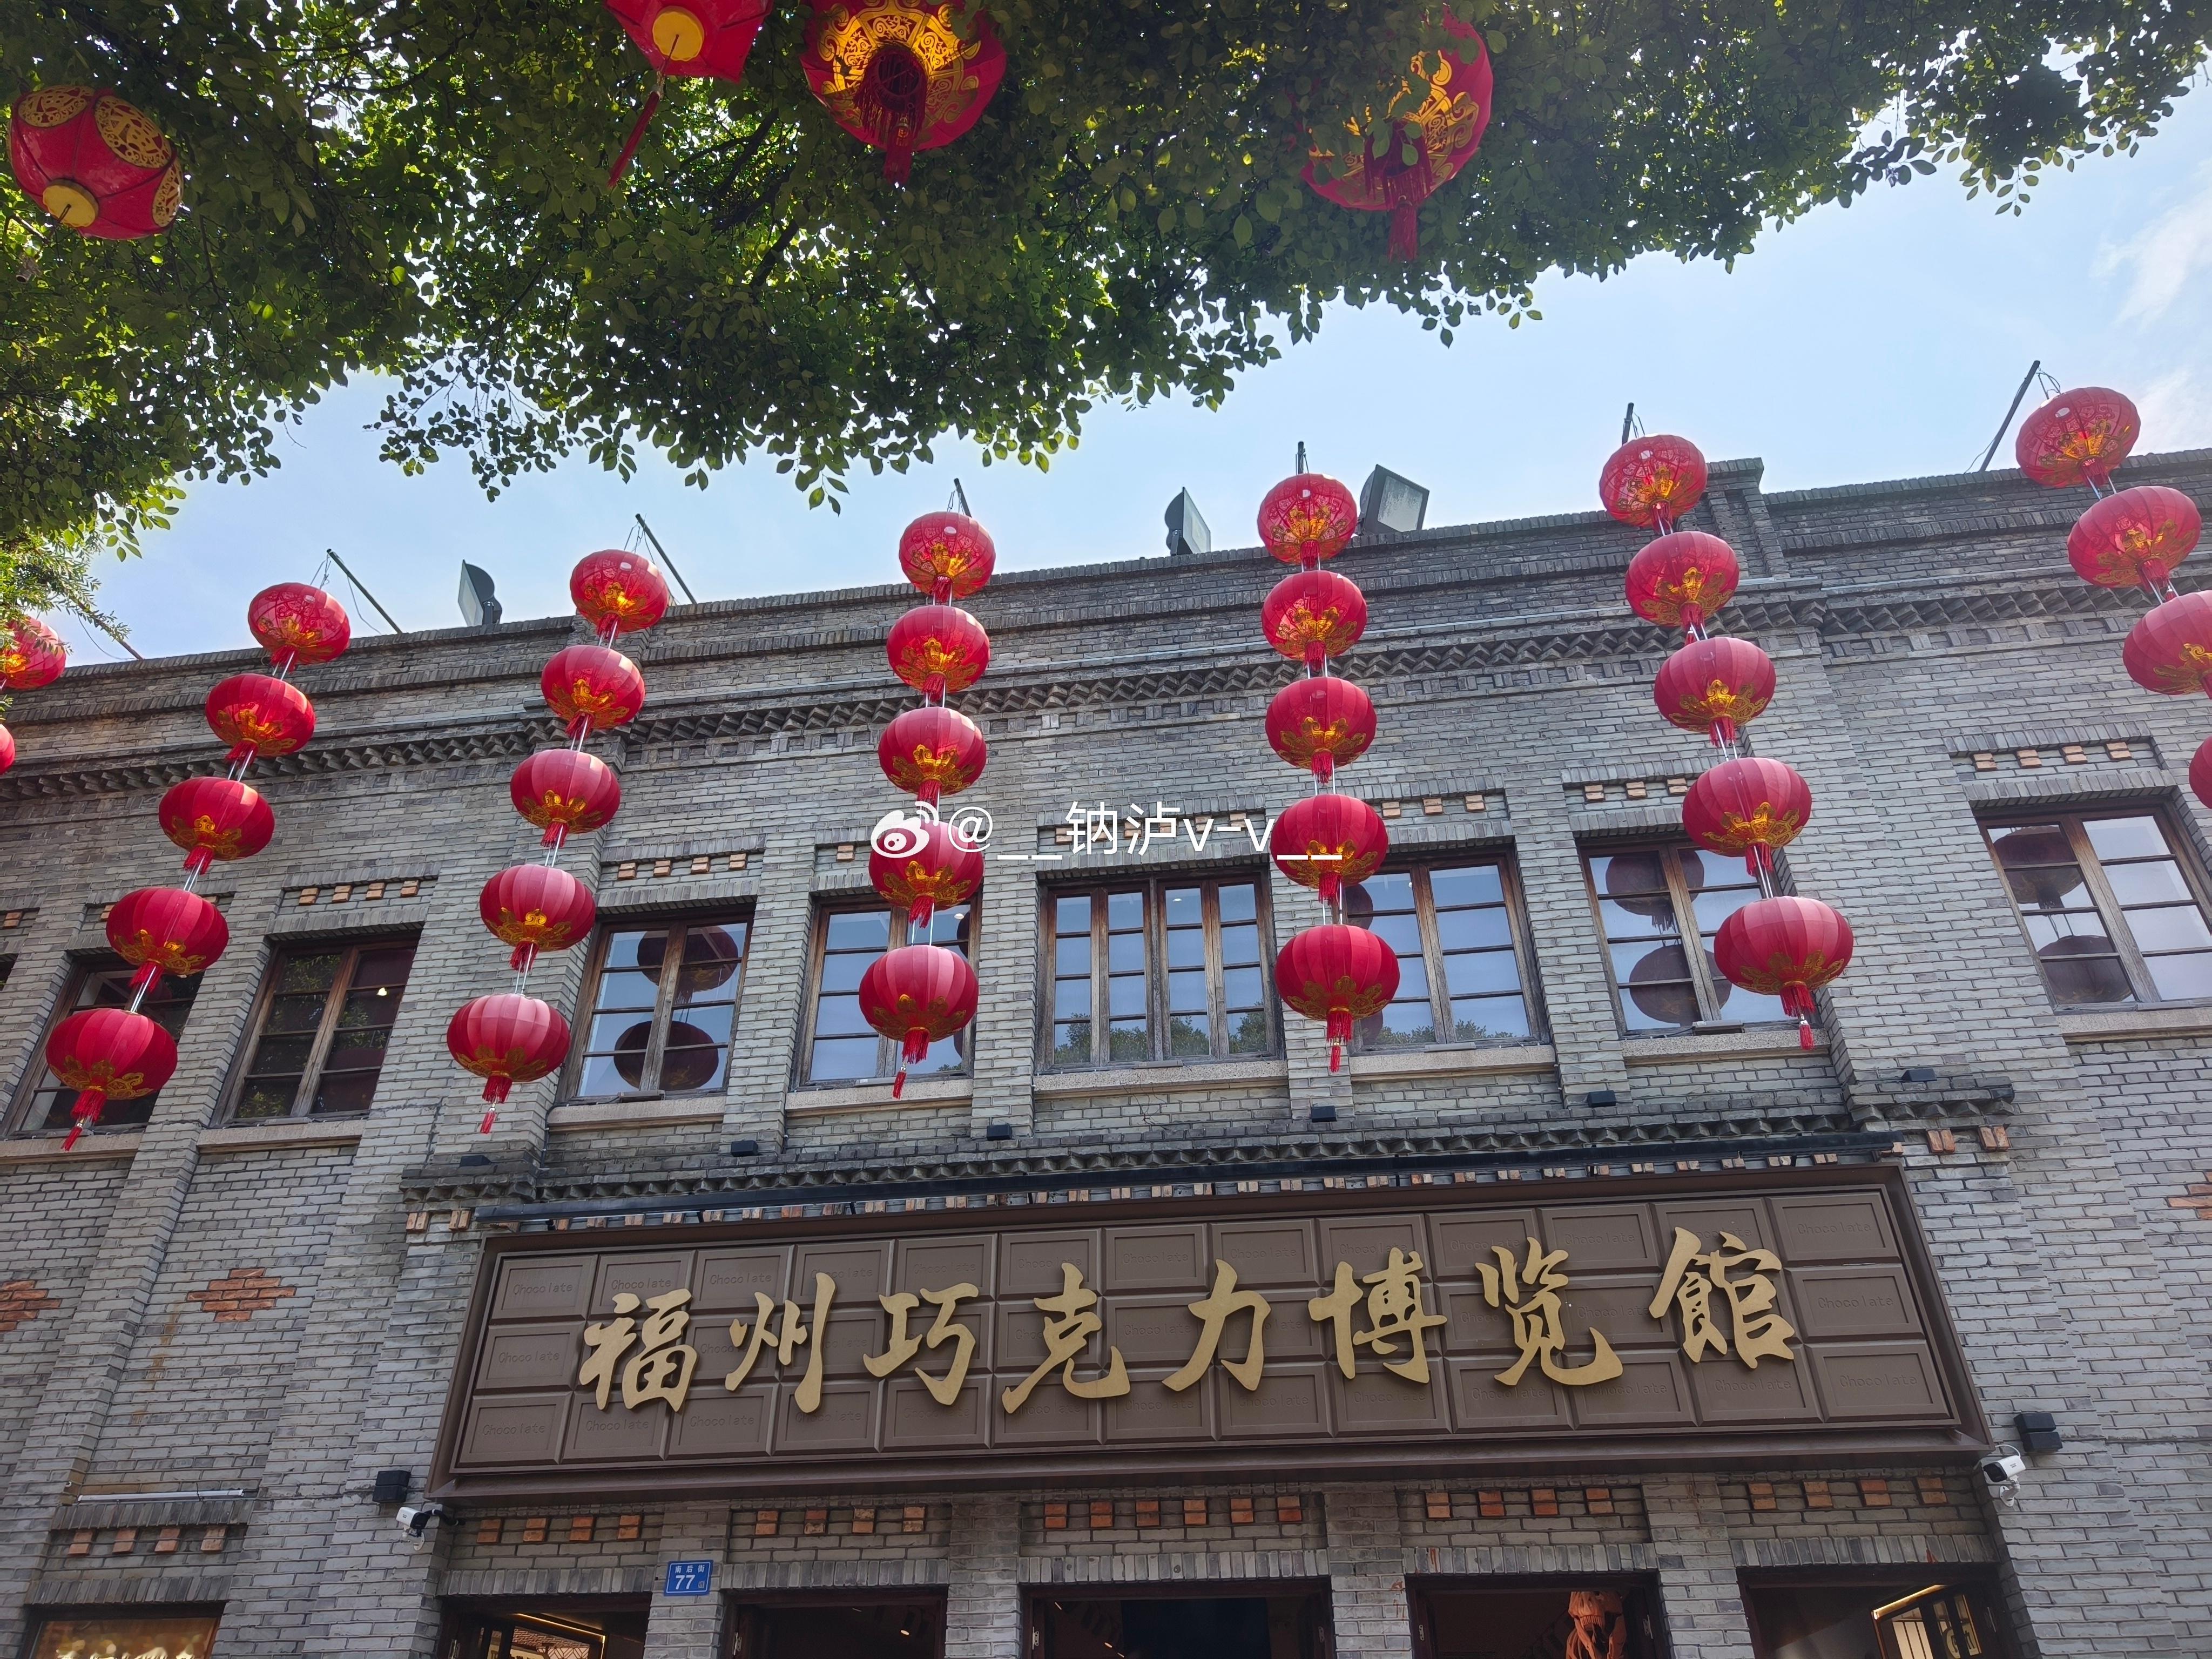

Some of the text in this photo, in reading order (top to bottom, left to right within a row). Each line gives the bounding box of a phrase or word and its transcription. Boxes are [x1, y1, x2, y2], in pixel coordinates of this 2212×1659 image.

[675, 1564, 705, 1573] 南后街
[676, 1574, 696, 1590] 77
